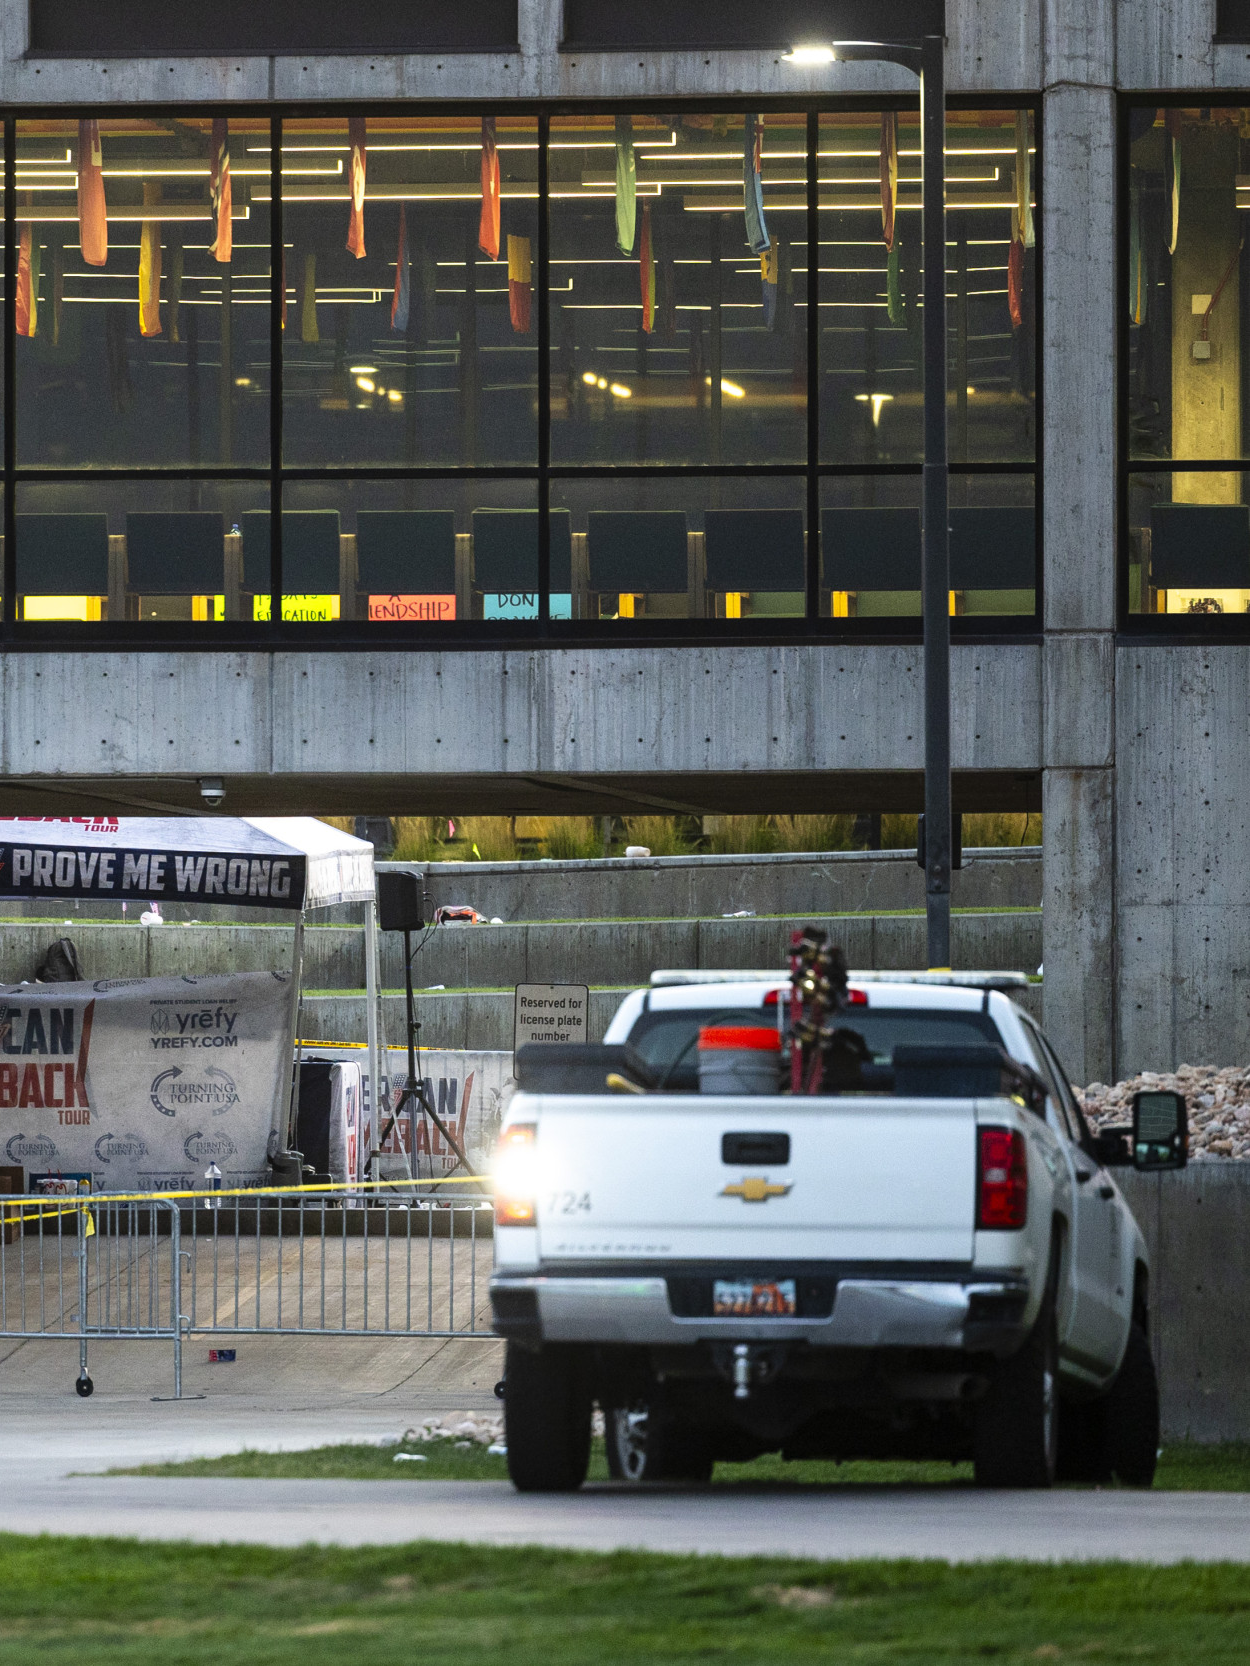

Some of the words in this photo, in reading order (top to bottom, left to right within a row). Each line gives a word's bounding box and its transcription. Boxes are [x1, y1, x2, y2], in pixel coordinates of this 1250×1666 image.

[369, 601, 449, 620] IENDSHIP
[84, 824, 119, 833] TOUR
[12, 850, 117, 889] PROVE
[122, 853, 167, 891] ME
[174, 855, 291, 898] WRONG
[520, 997, 566, 1008] Reserved
[568, 998, 583, 1008] for
[520, 1014, 555, 1025] license
[557, 1015, 582, 1027] plate
[531, 1031, 570, 1041] number
[150, 1035, 238, 1049] YREFY.COM
[169, 1083, 235, 1094] TURNING
[169, 1094, 215, 1103] POINT
[215, 1093, 241, 1103] USA
[58, 1110, 91, 1125] TOUR
[107, 1142, 145, 1150] TURNING
